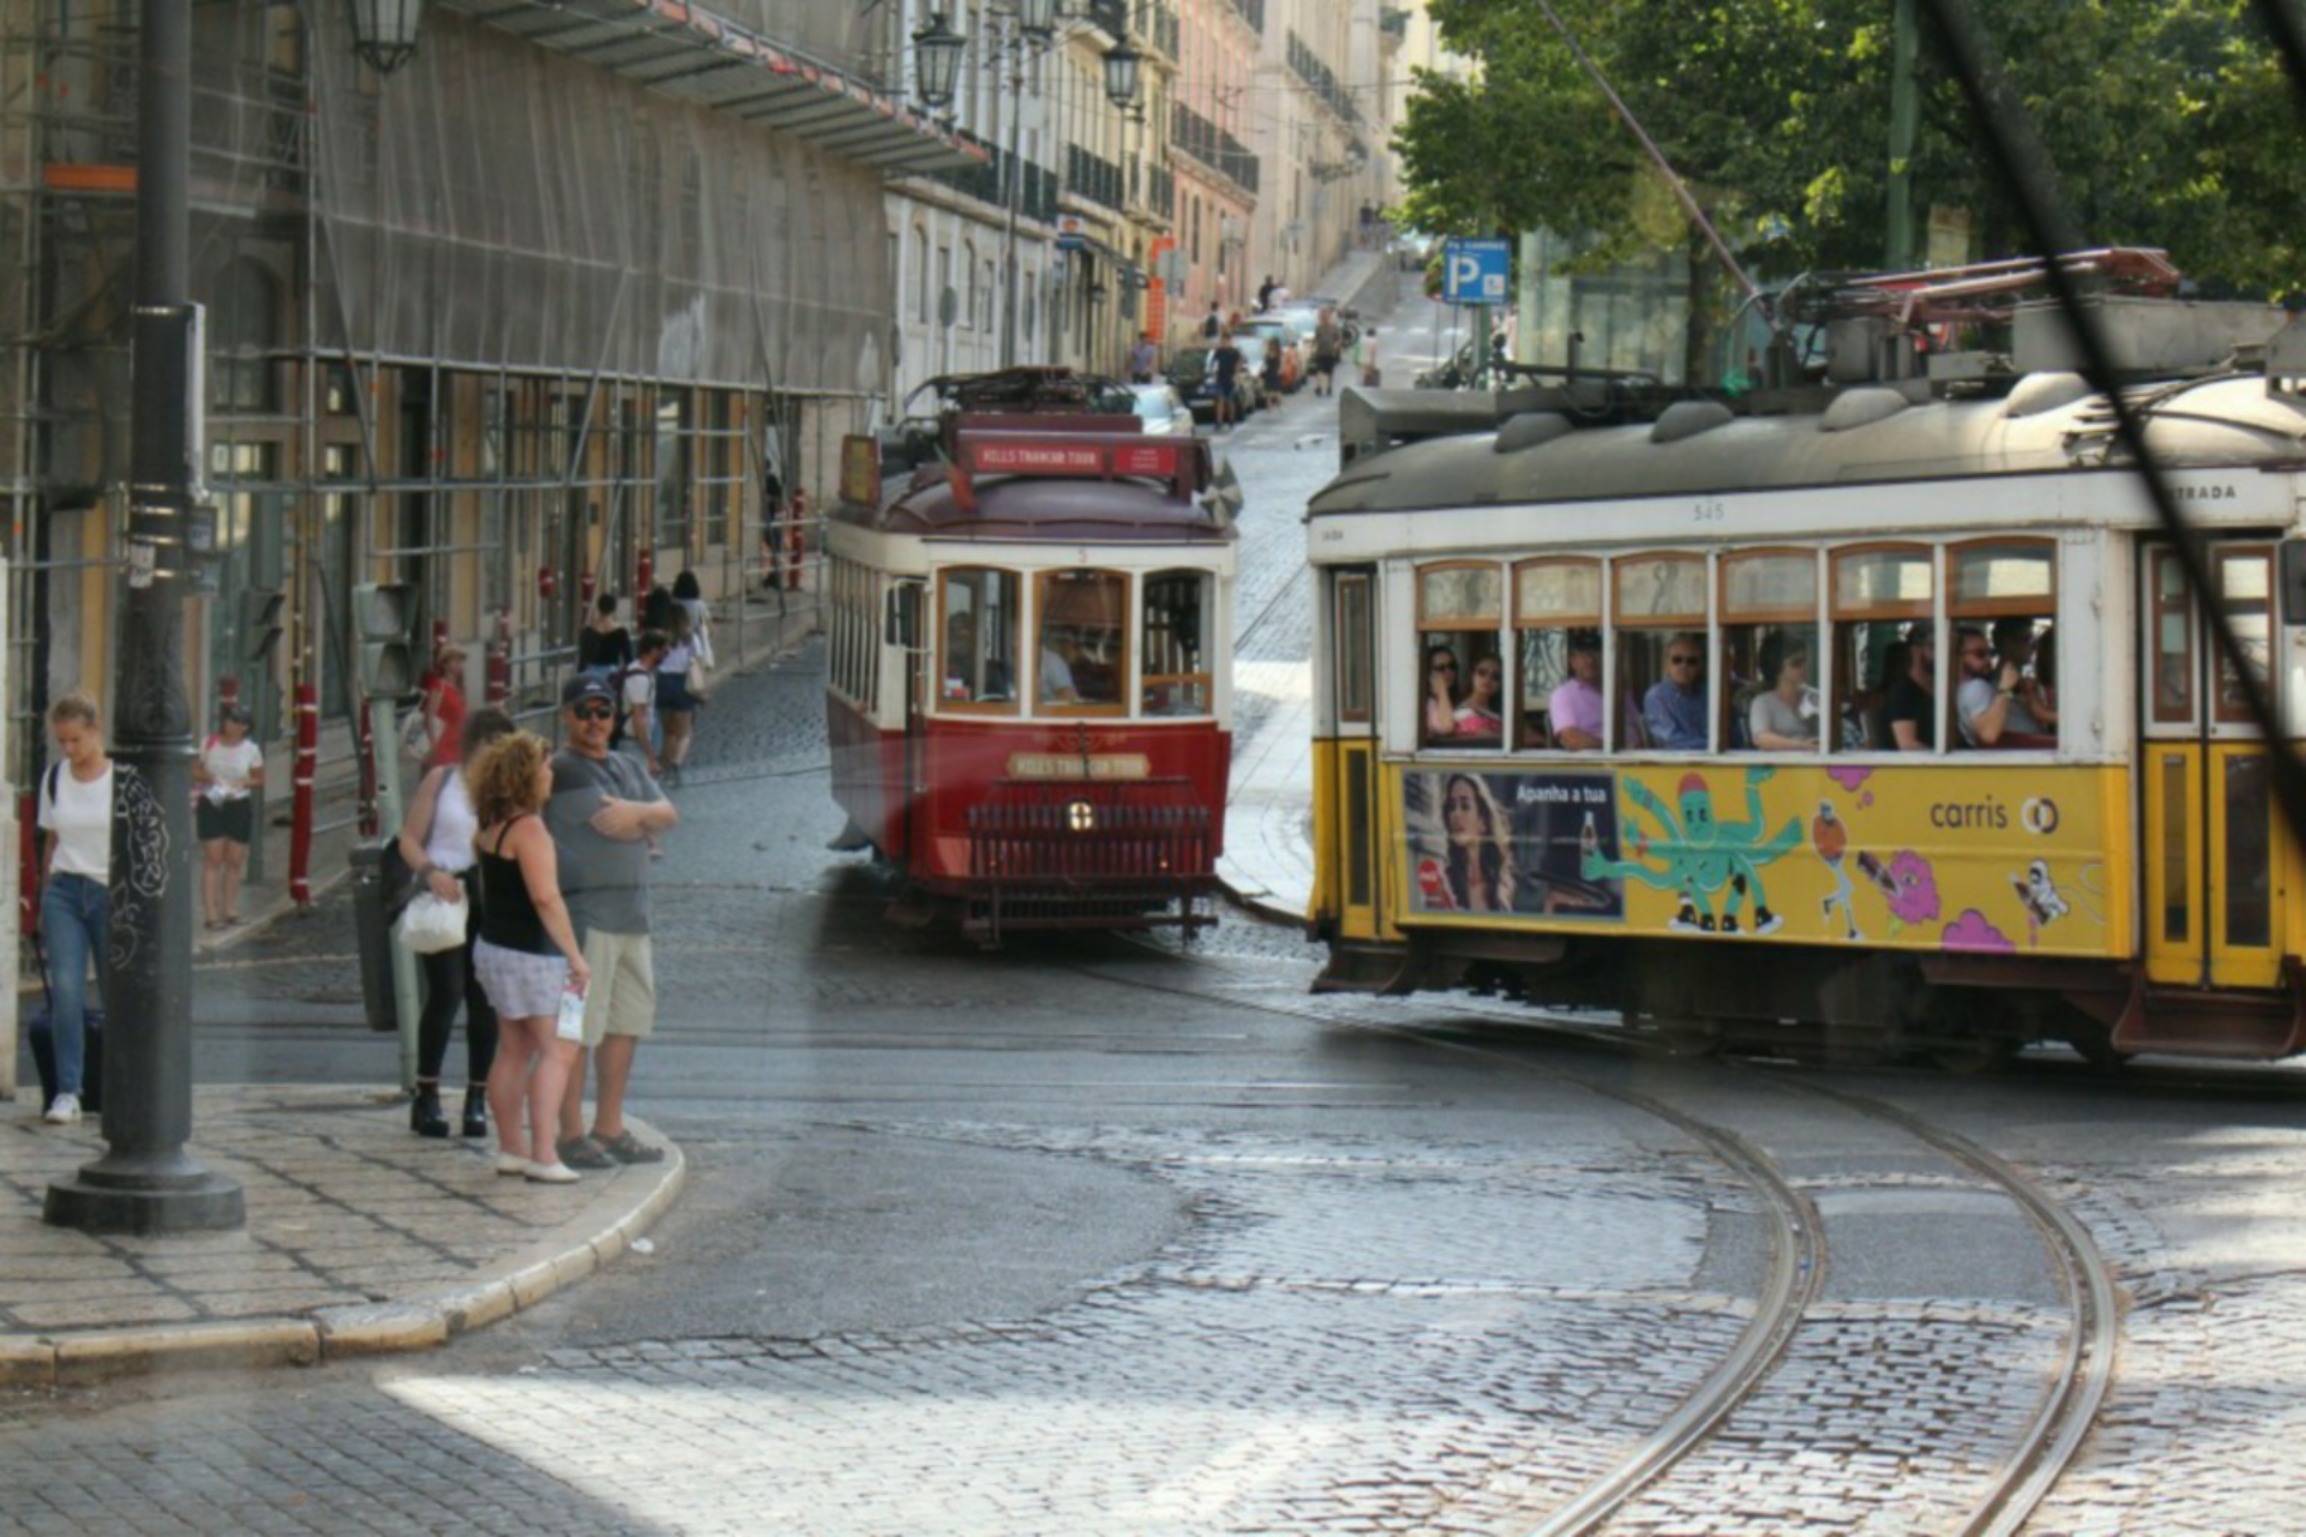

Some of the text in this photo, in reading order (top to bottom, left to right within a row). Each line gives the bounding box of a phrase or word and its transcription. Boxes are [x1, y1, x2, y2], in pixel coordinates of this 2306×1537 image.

[1449, 256, 1480, 295] P
[2170, 485, 2236, 500] TRADA
[1516, 784, 1607, 804] Apanha a tua
[1930, 794, 2008, 829] carris
